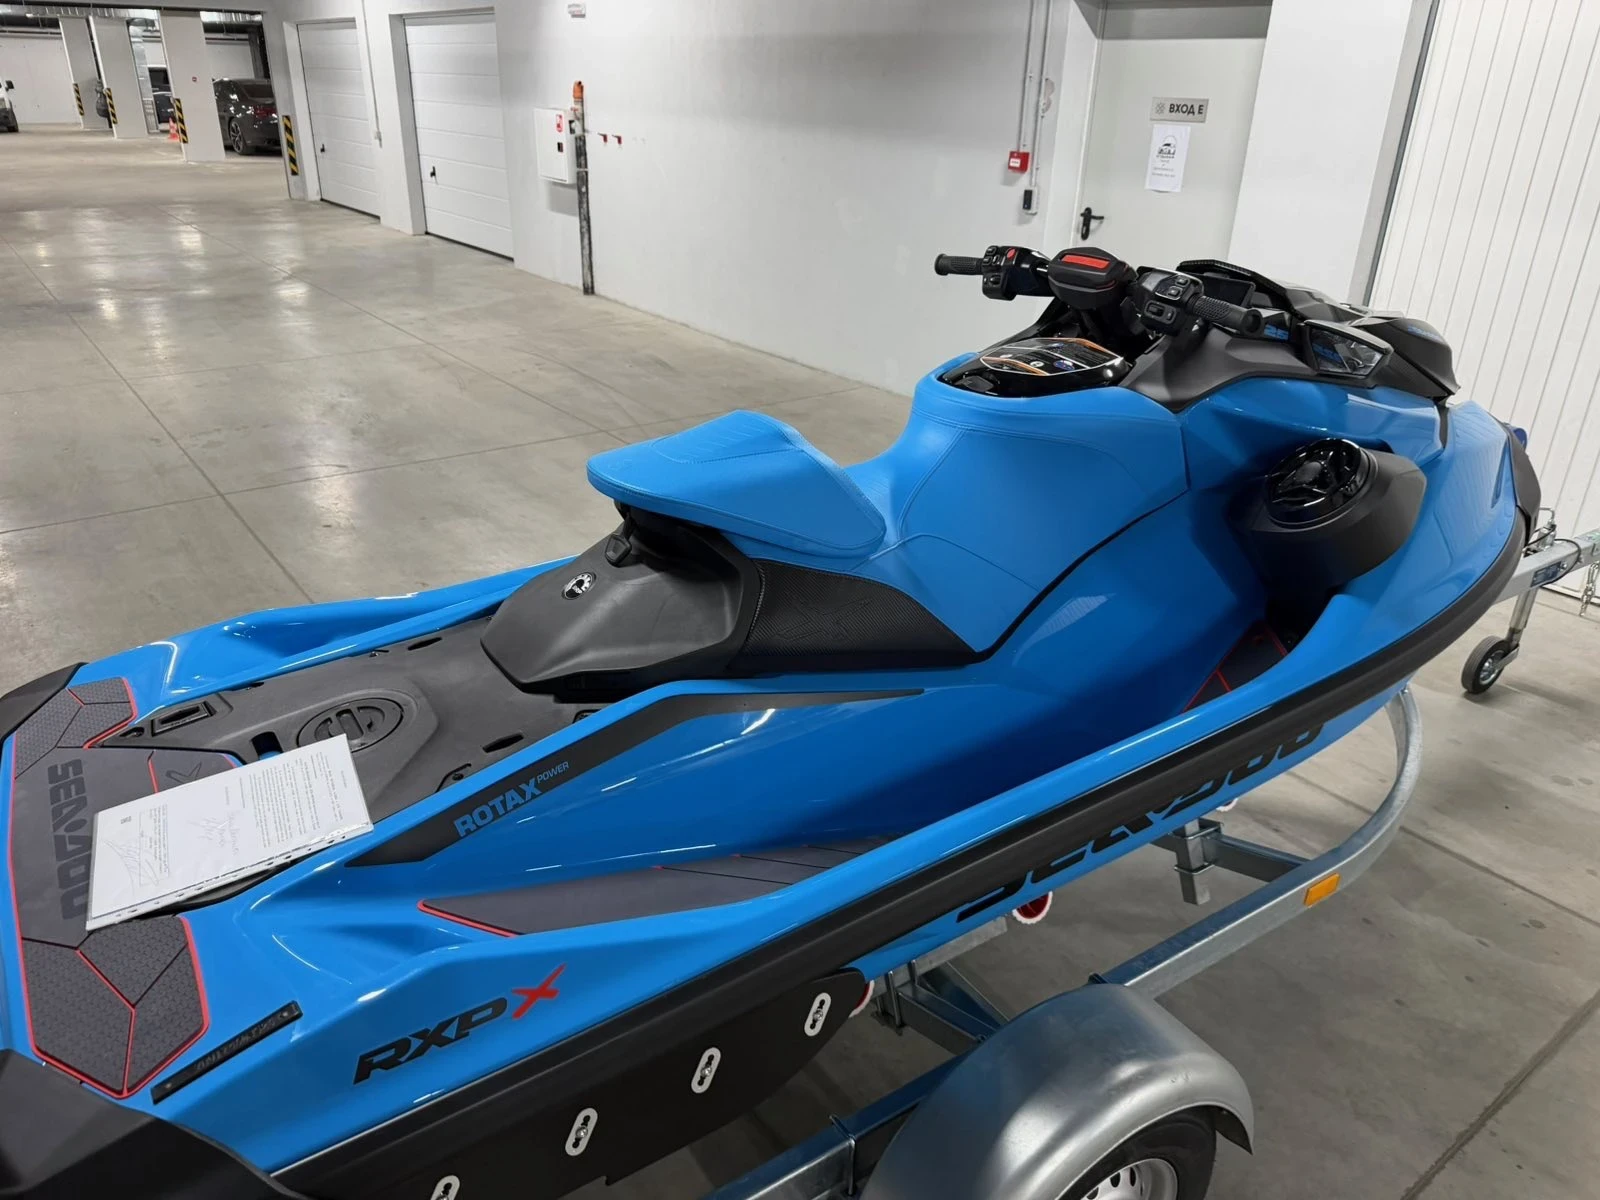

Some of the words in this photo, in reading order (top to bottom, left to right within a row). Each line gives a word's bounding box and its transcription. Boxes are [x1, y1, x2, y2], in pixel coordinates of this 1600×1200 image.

[1169, 103, 1195, 115] ВХОД
[1198, 104, 1204, 114] Е
[453, 777, 542, 837] ROTAX
[536, 761, 570, 784] POWER
